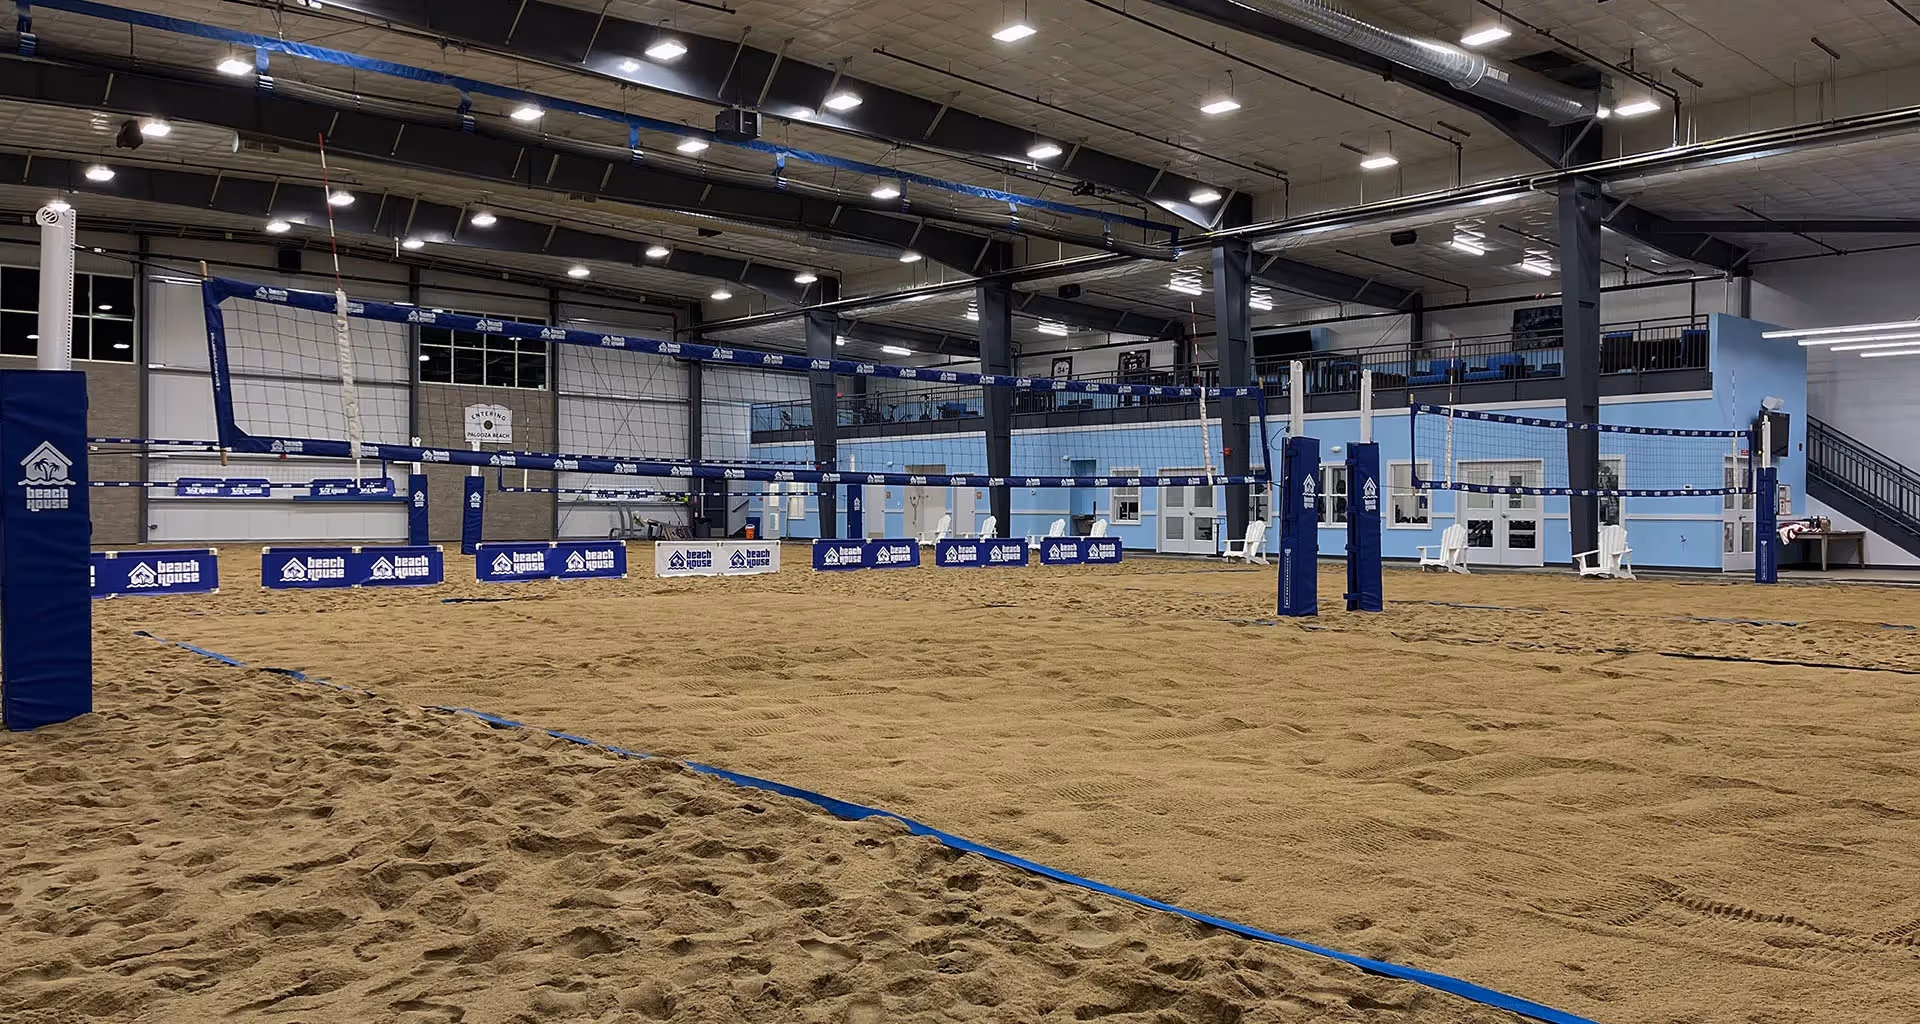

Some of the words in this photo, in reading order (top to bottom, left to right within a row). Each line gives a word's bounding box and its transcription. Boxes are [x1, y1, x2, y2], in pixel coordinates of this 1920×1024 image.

[471, 411, 506, 420] ENTERING
[26, 486, 68, 498] beach
[585, 549, 614, 560] beach
[686, 549, 711, 559] beach
[747, 549, 770, 558] beach
[840, 546, 861, 555] beach
[890, 545, 910, 554] beach
[395, 555, 428, 566] beach
[513, 551, 544, 562] beach
[157, 560, 199, 573] beach
[308, 557, 344, 568] beach
